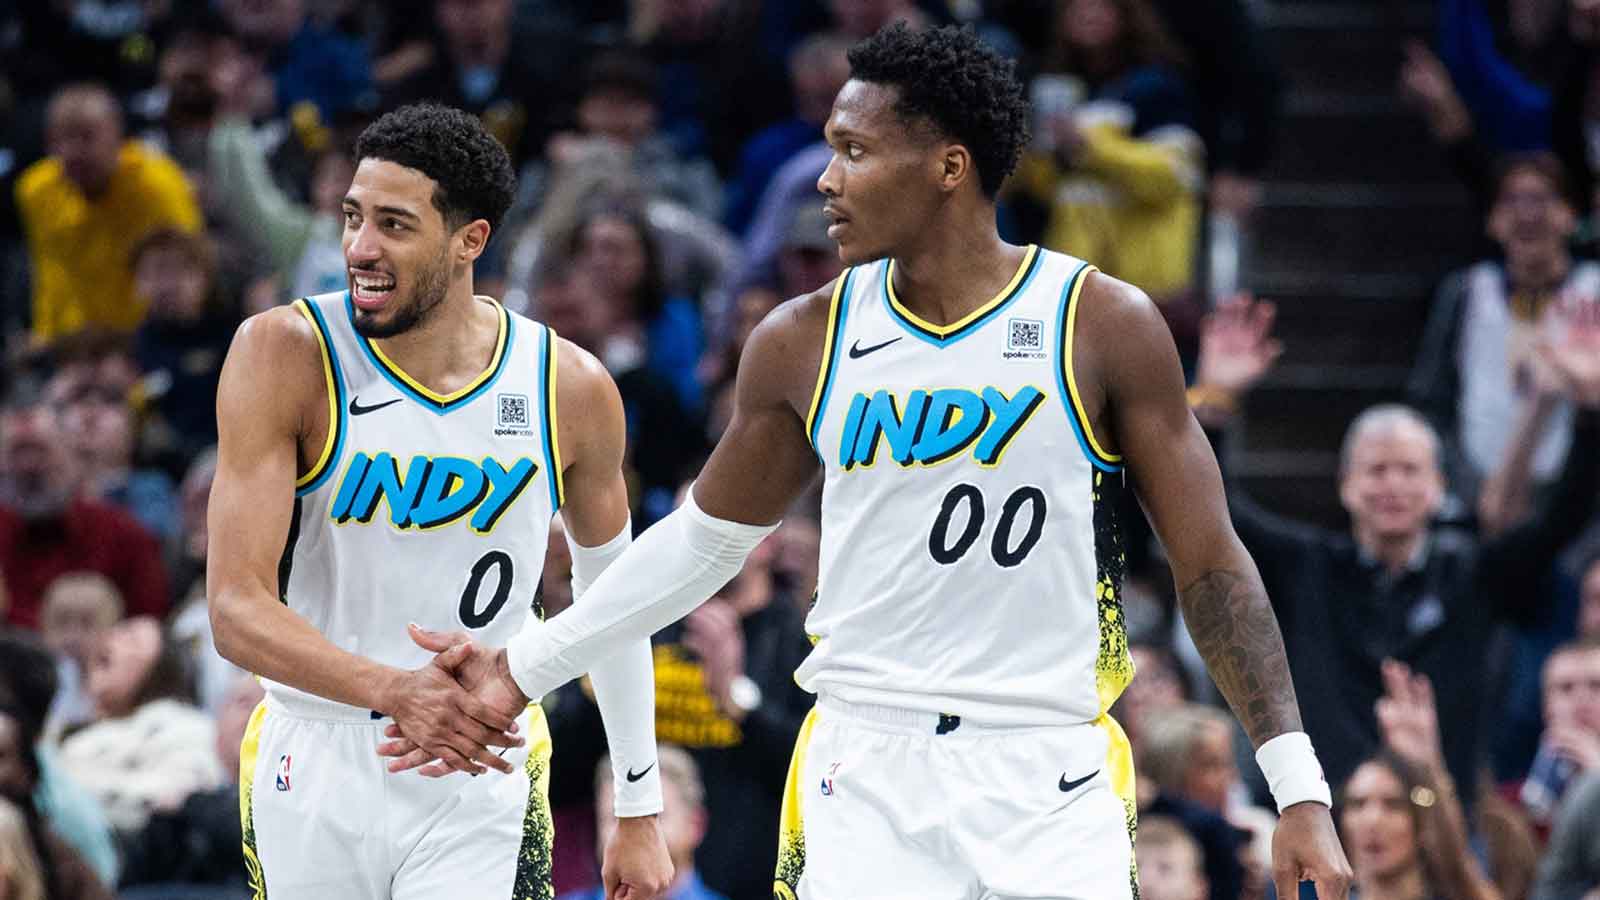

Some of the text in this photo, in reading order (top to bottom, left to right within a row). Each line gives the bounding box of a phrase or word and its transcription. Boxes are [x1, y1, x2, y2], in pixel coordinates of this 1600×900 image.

[838, 384, 1046, 470] INDY
[330, 452, 538, 535] INDY
[928, 482, 1047, 568] 00
[458, 549, 514, 628] 0
